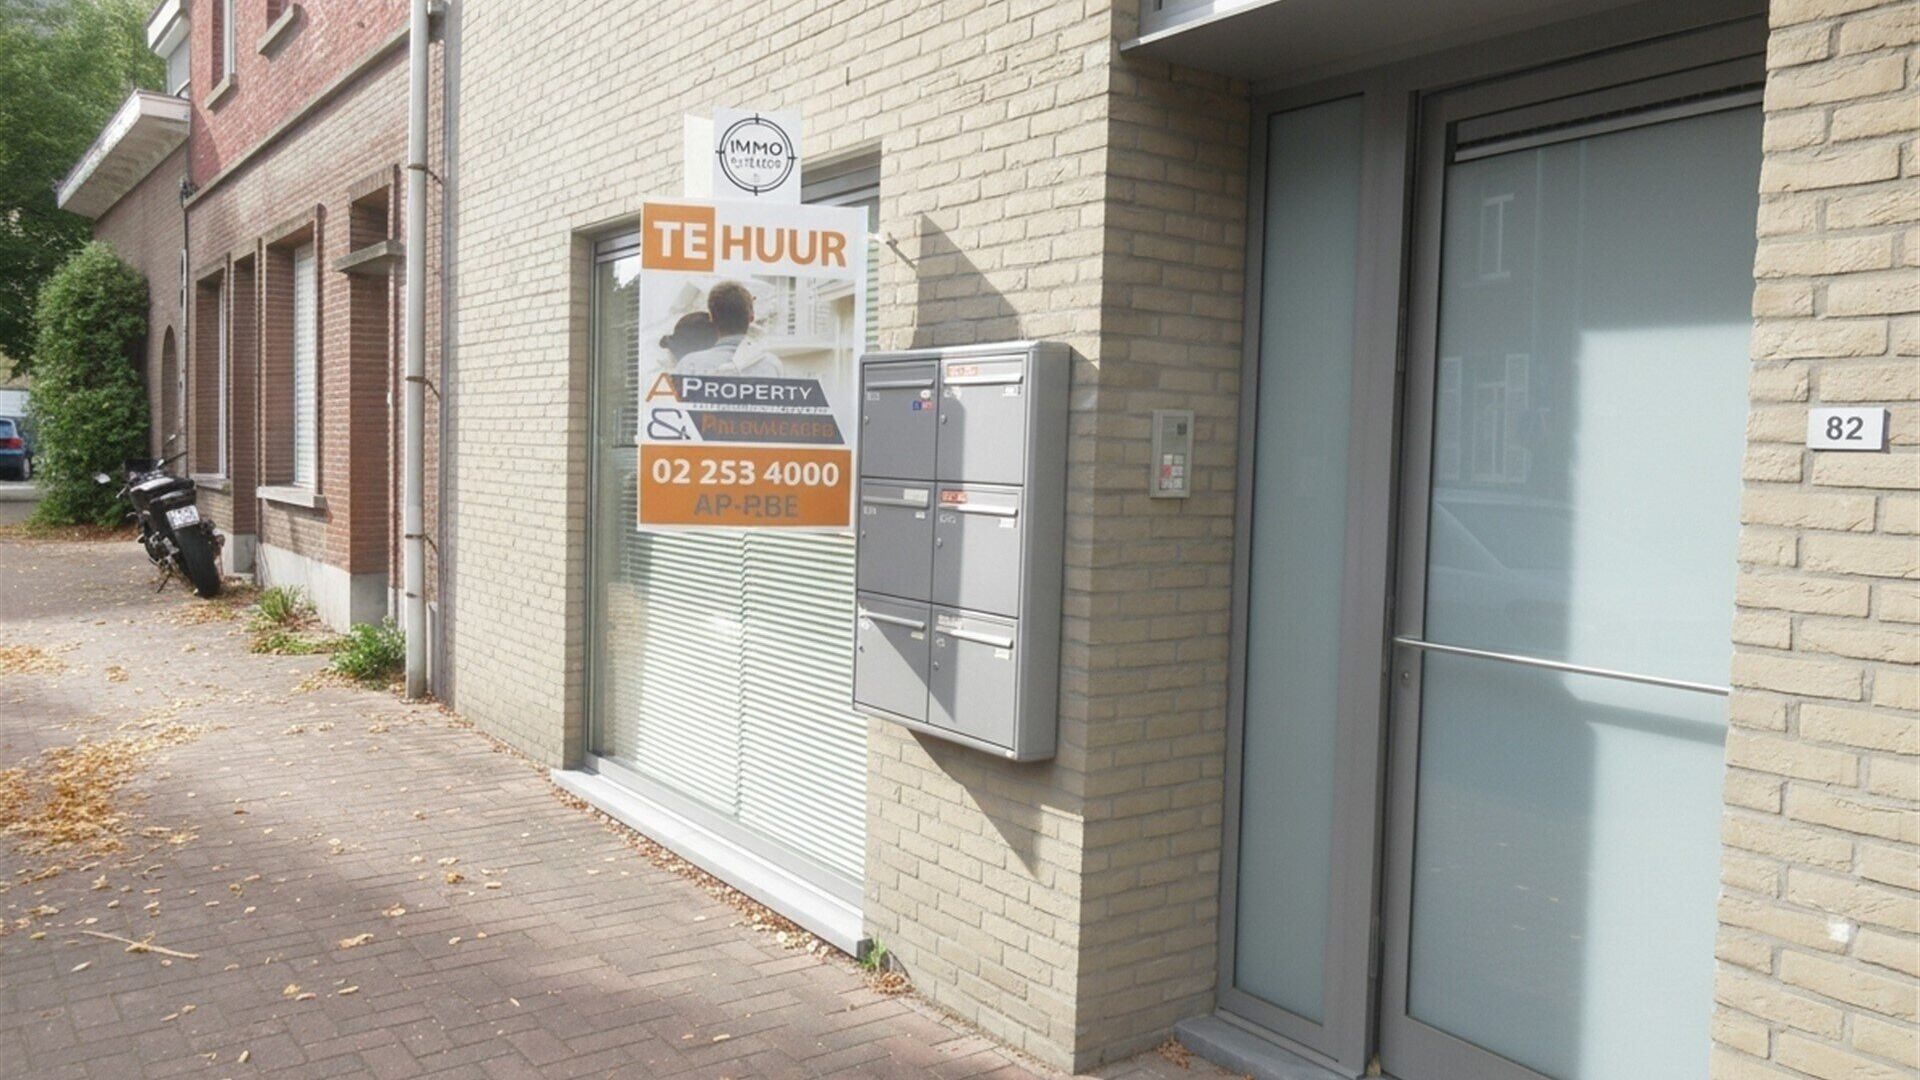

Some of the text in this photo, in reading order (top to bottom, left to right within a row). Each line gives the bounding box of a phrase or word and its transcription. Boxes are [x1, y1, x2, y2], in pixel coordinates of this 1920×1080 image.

[730, 139, 783, 156] IMMO
[653, 220, 847, 268] TE HUUR
[1825, 415, 1864, 440] 82
[652, 458, 840, 487] 02 253 4000
